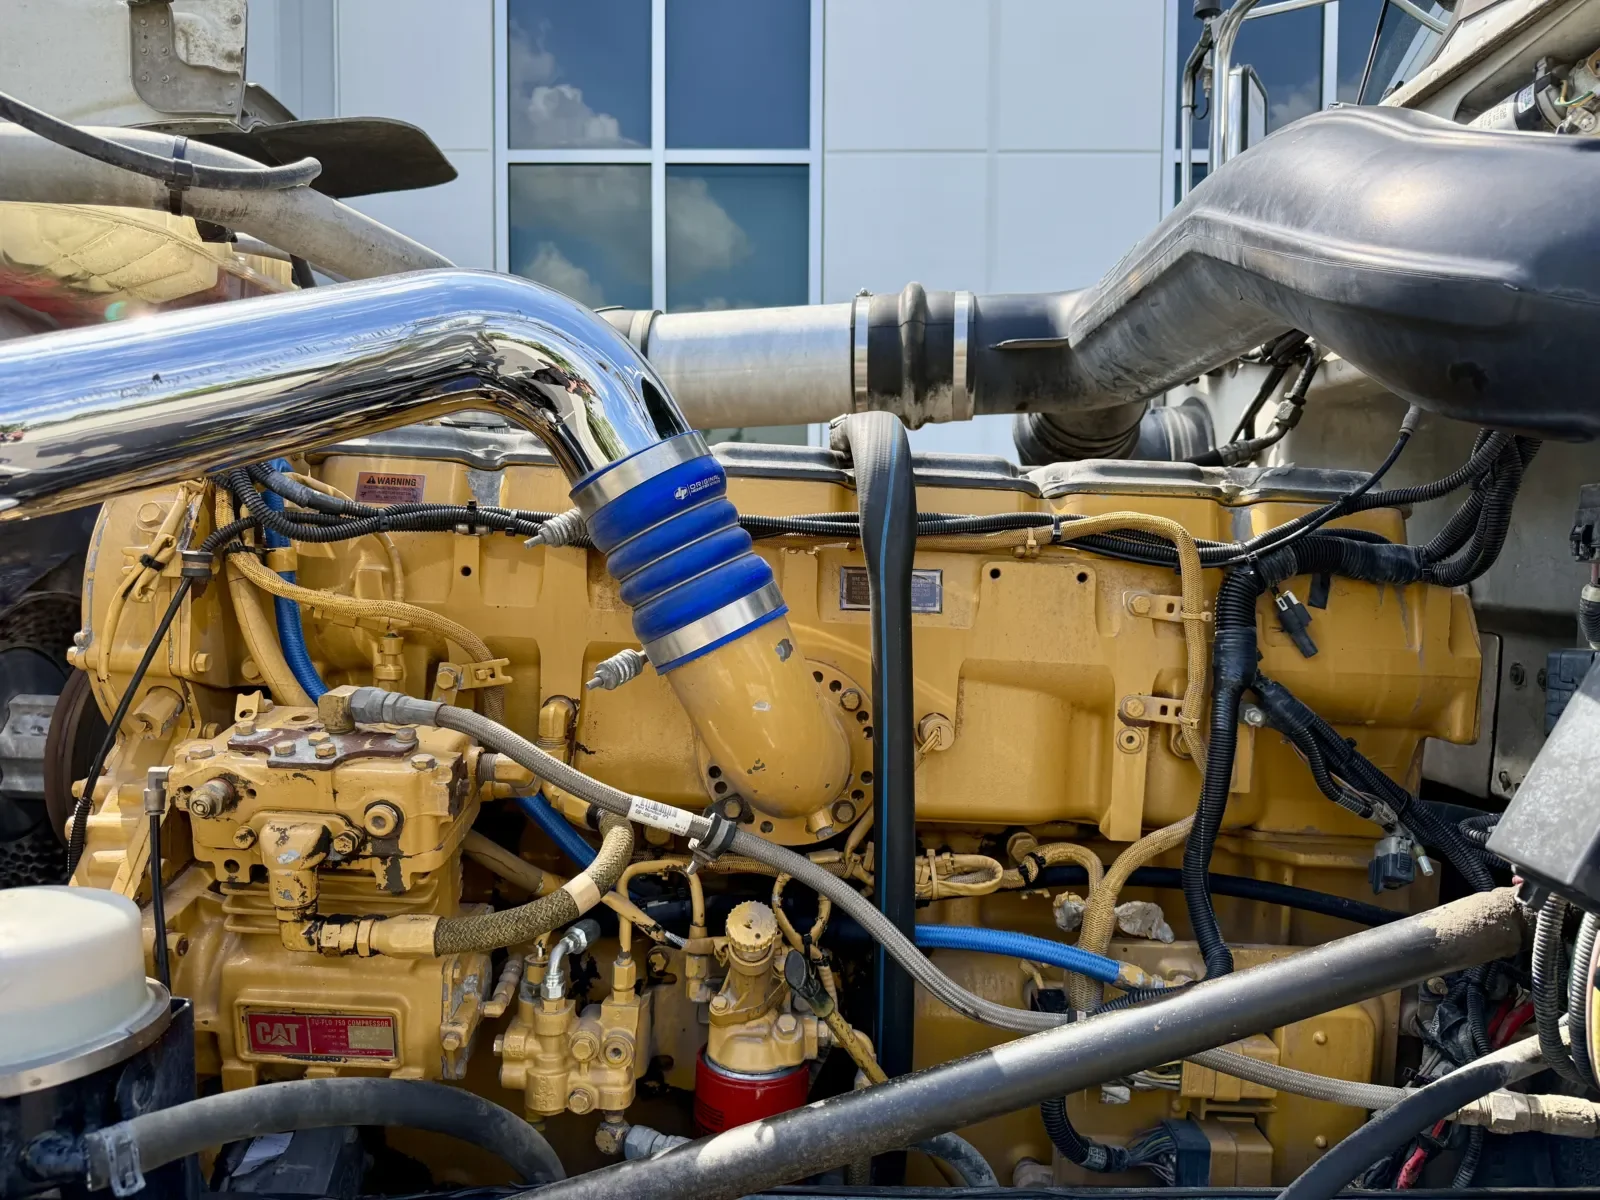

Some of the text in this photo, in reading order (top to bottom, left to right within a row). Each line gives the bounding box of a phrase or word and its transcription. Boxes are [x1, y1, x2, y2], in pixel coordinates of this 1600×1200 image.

[377, 476, 417, 486] WARNING
[689, 475, 720, 490] ORIGINAL
[311, 1018, 333, 1027] TU-FLO
[347, 1019, 389, 1028] COMPRESSOR
[256, 1022, 299, 1047] CAT
